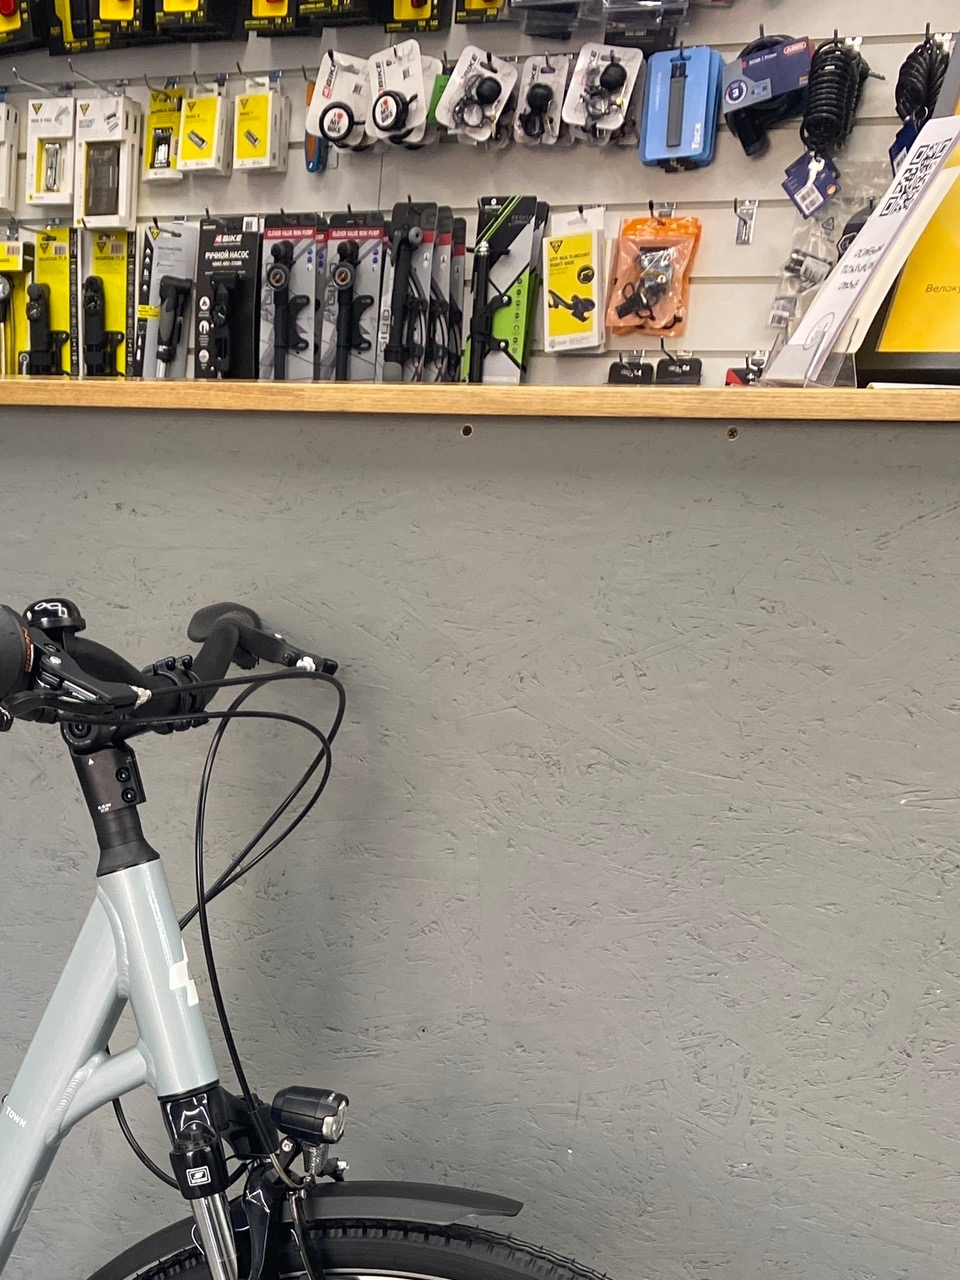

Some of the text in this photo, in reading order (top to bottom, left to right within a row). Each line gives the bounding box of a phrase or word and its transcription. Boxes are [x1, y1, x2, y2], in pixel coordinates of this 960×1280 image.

[205, 250, 249, 259] РУЧНОЙ НАСОС
[6, 1106, 27, 1128] TOWN
